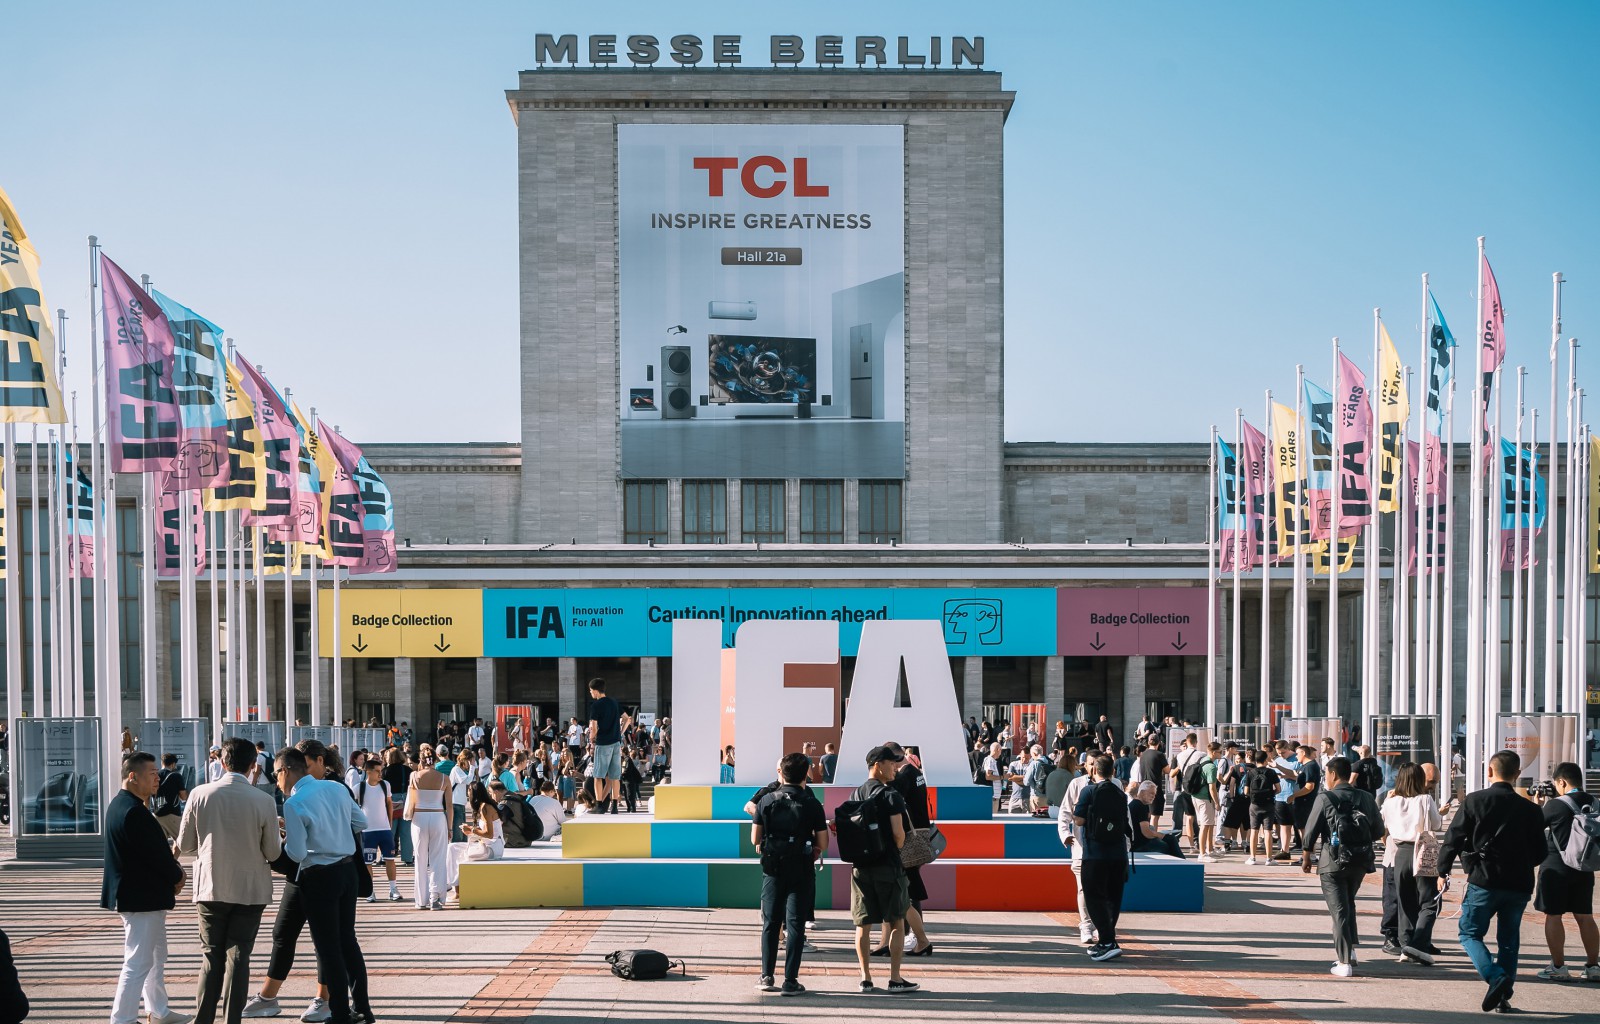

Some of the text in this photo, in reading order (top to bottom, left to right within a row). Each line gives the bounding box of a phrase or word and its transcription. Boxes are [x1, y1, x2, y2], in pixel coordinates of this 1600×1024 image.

[535, 34, 985, 66] MESSE BERLIN
[693, 155, 830, 198] TCL
[651, 213, 872, 230] INSPIRE GREATNESS
[737, 250, 787, 263] Hall 21a
[119, 360, 178, 459] IFA
[1347, 386, 1365, 428] YEARS
[1289, 430, 1297, 467] YEARS
[1379, 422, 1400, 502] IFA
[252, 438, 292, 517] IFA
[1341, 441, 1373, 517] IFA
[331, 493, 364, 558] IFA
[1283, 479, 1311, 547] IFA
[352, 614, 453, 628] Badge Collection
[506, 606, 565, 639] IFA
[572, 606, 624, 615] Innovation
[572, 618, 603, 627] For All
[648, 605, 725, 622] Caution!
[730, 605, 828, 621] Innovation
[1090, 613, 1190, 627] Badge Collection
[672, 618, 974, 786] IFA
